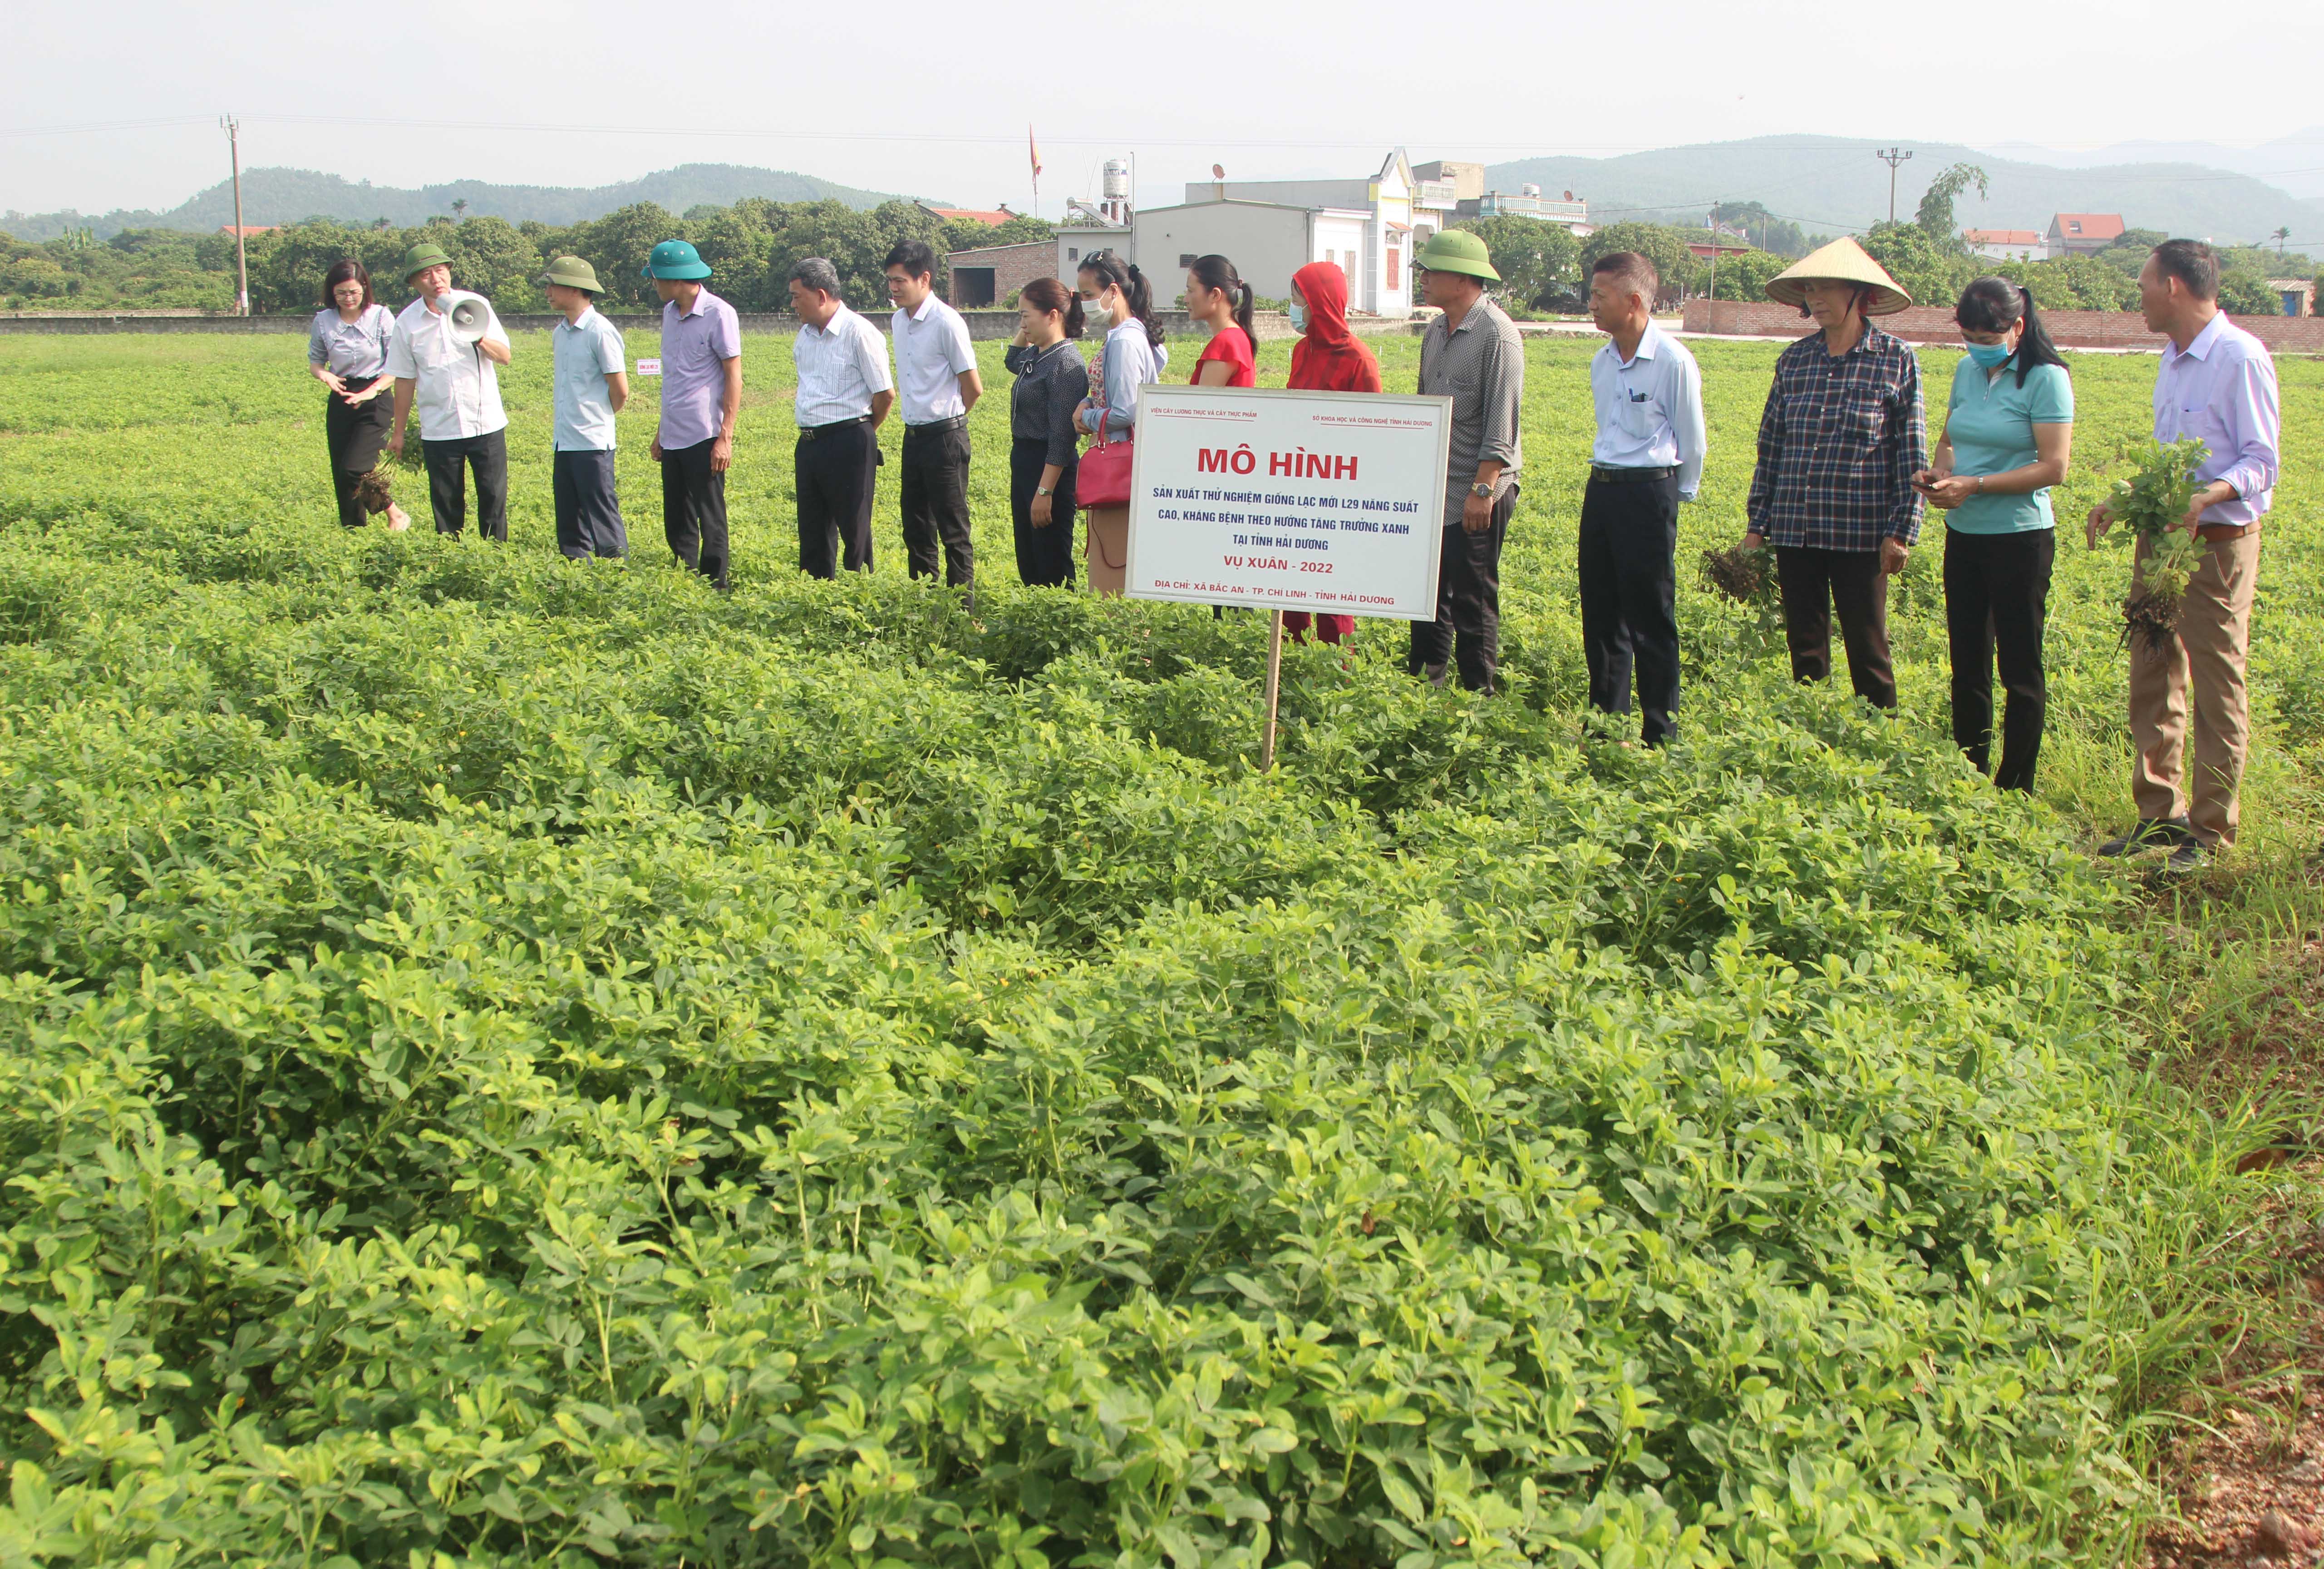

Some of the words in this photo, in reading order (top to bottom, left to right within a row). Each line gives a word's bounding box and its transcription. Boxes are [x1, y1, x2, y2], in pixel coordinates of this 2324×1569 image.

[1198, 443, 1256, 474] MÔ
[1269, 447, 1358, 480] HÌNH
[1153, 484, 1173, 498] SẢN
[1175, 487, 1200, 499] XUẤT
[1202, 487, 1222, 500] THỬ
[1223, 491, 1262, 505] NGHIỆM
[1265, 492, 1295, 505] GIỐNG
[1297, 496, 1316, 508] LẠC
[1319, 495, 1338, 508] MỚI
[1341, 499, 1359, 509] L29
[1362, 498, 1390, 511] NĂNG
[1393, 499, 1419, 513] SUẤT
[1158, 509, 1180, 521] CAO,
[1183, 510, 1216, 522] KHÁNG
[1218, 511, 1245, 525] BỆNH
[1247, 515, 1271, 525] THEO
[1274, 514, 1308, 528] HƯỚNG
[1310, 517, 1336, 529] TĂNG
[1339, 518, 1379, 532] TRƯỞNG
[1381, 523, 1409, 534] XANH
[1233, 534, 1248, 547] TẠI
[1251, 533, 1273, 546] TỈNH
[1275, 534, 1292, 548] HẢI
[1295, 538, 1329, 550] DƯƠNG
[1224, 556, 1243, 569] VỤ
[1247, 557, 1288, 570] XUÂN
[1300, 562, 1333, 573] 2022
[1155, 580, 1171, 590] ĐỊA
[1173, 579, 1191, 589] CHỈ:
[1193, 582, 1206, 590] XÃ
[1209, 581, 1228, 592] BẮC
[1267, 587, 1284, 596] CHÍ
[1315, 590, 1336, 600] TỈNH
[1340, 592, 1357, 601] HẢI
[1359, 596, 1394, 604] DƯƠNG
